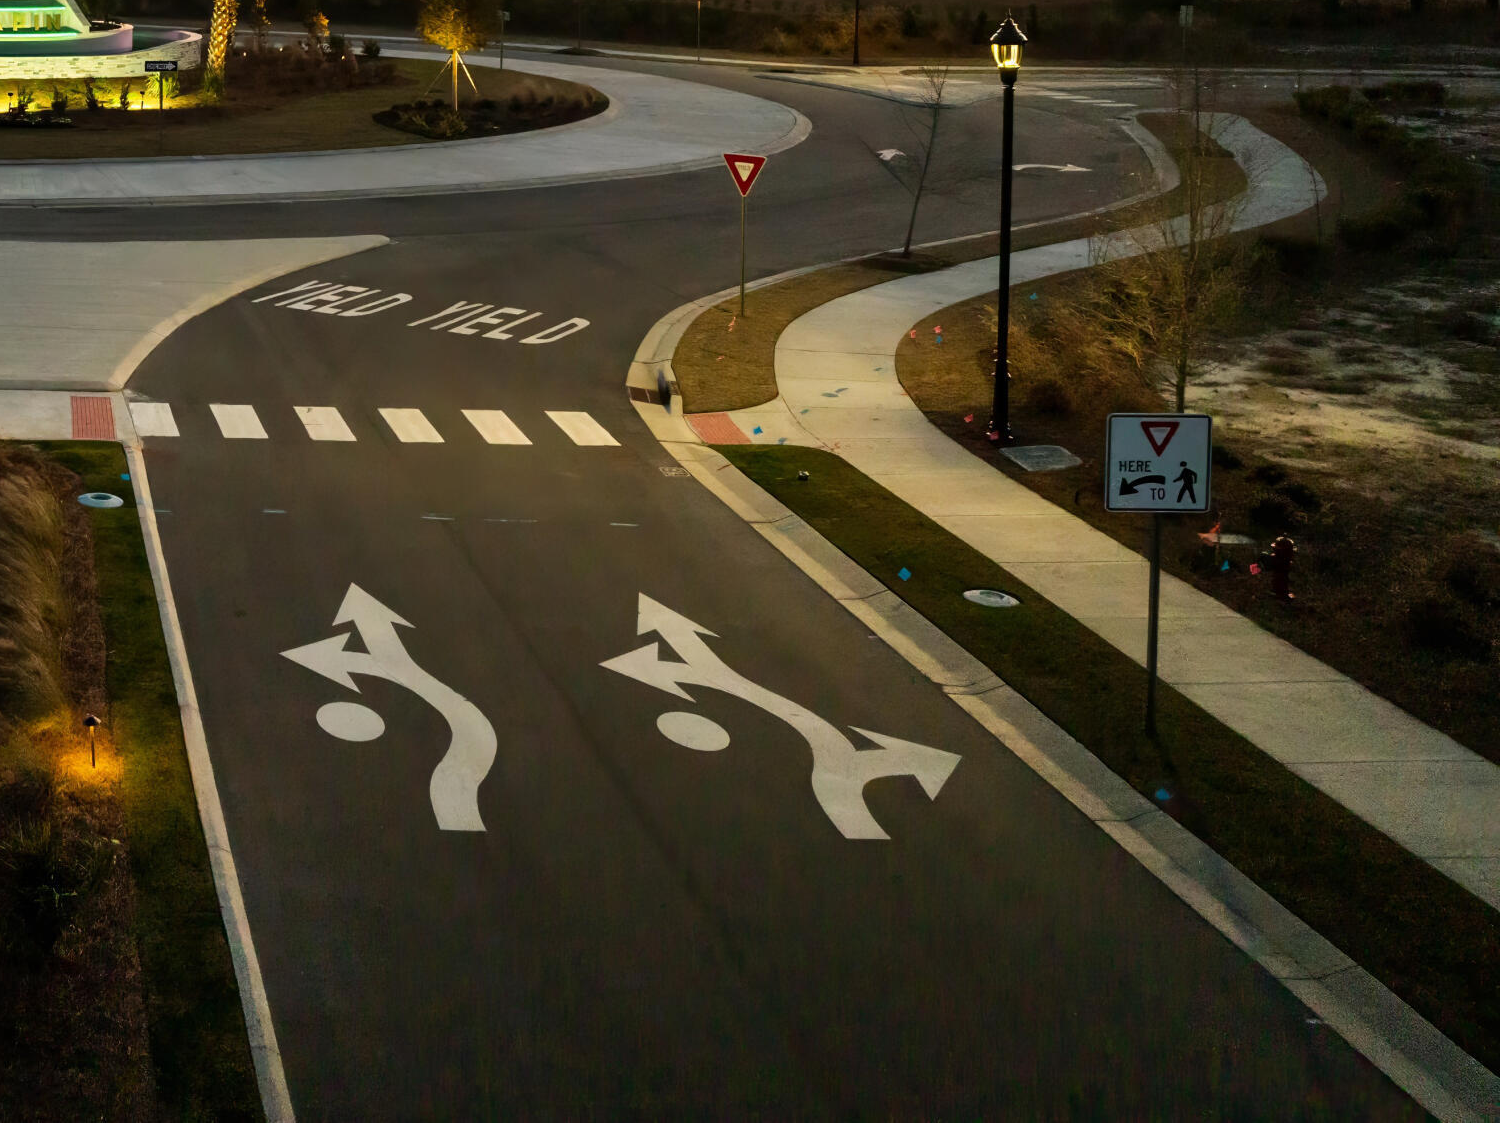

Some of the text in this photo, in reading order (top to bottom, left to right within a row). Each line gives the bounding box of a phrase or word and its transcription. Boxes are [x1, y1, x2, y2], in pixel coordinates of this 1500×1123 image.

[251, 280, 591, 344] YIELD YIELD
[1118, 460, 1152, 473] HERE
[1150, 487, 1166, 501] TO
